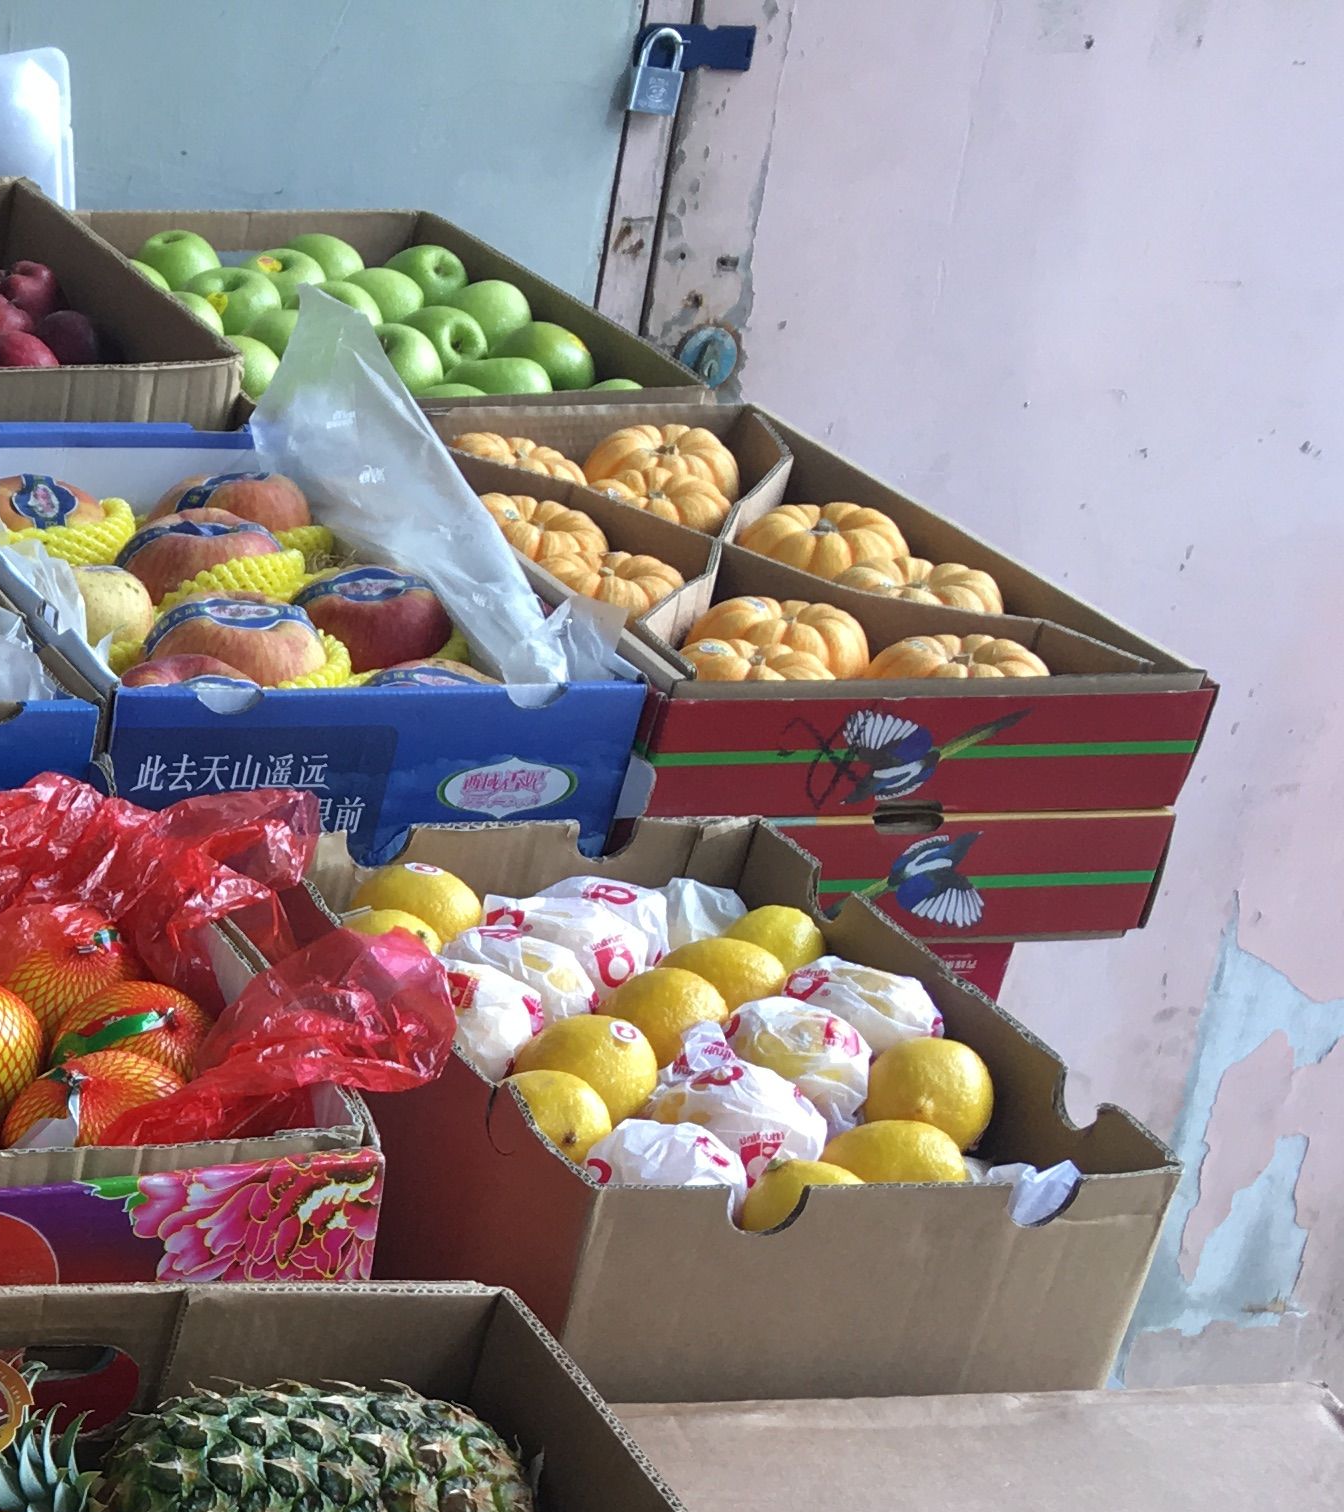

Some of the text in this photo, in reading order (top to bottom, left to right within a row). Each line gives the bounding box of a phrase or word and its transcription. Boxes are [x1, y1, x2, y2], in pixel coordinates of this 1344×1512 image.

[130, 753, 330, 792] 此去天山遥远
